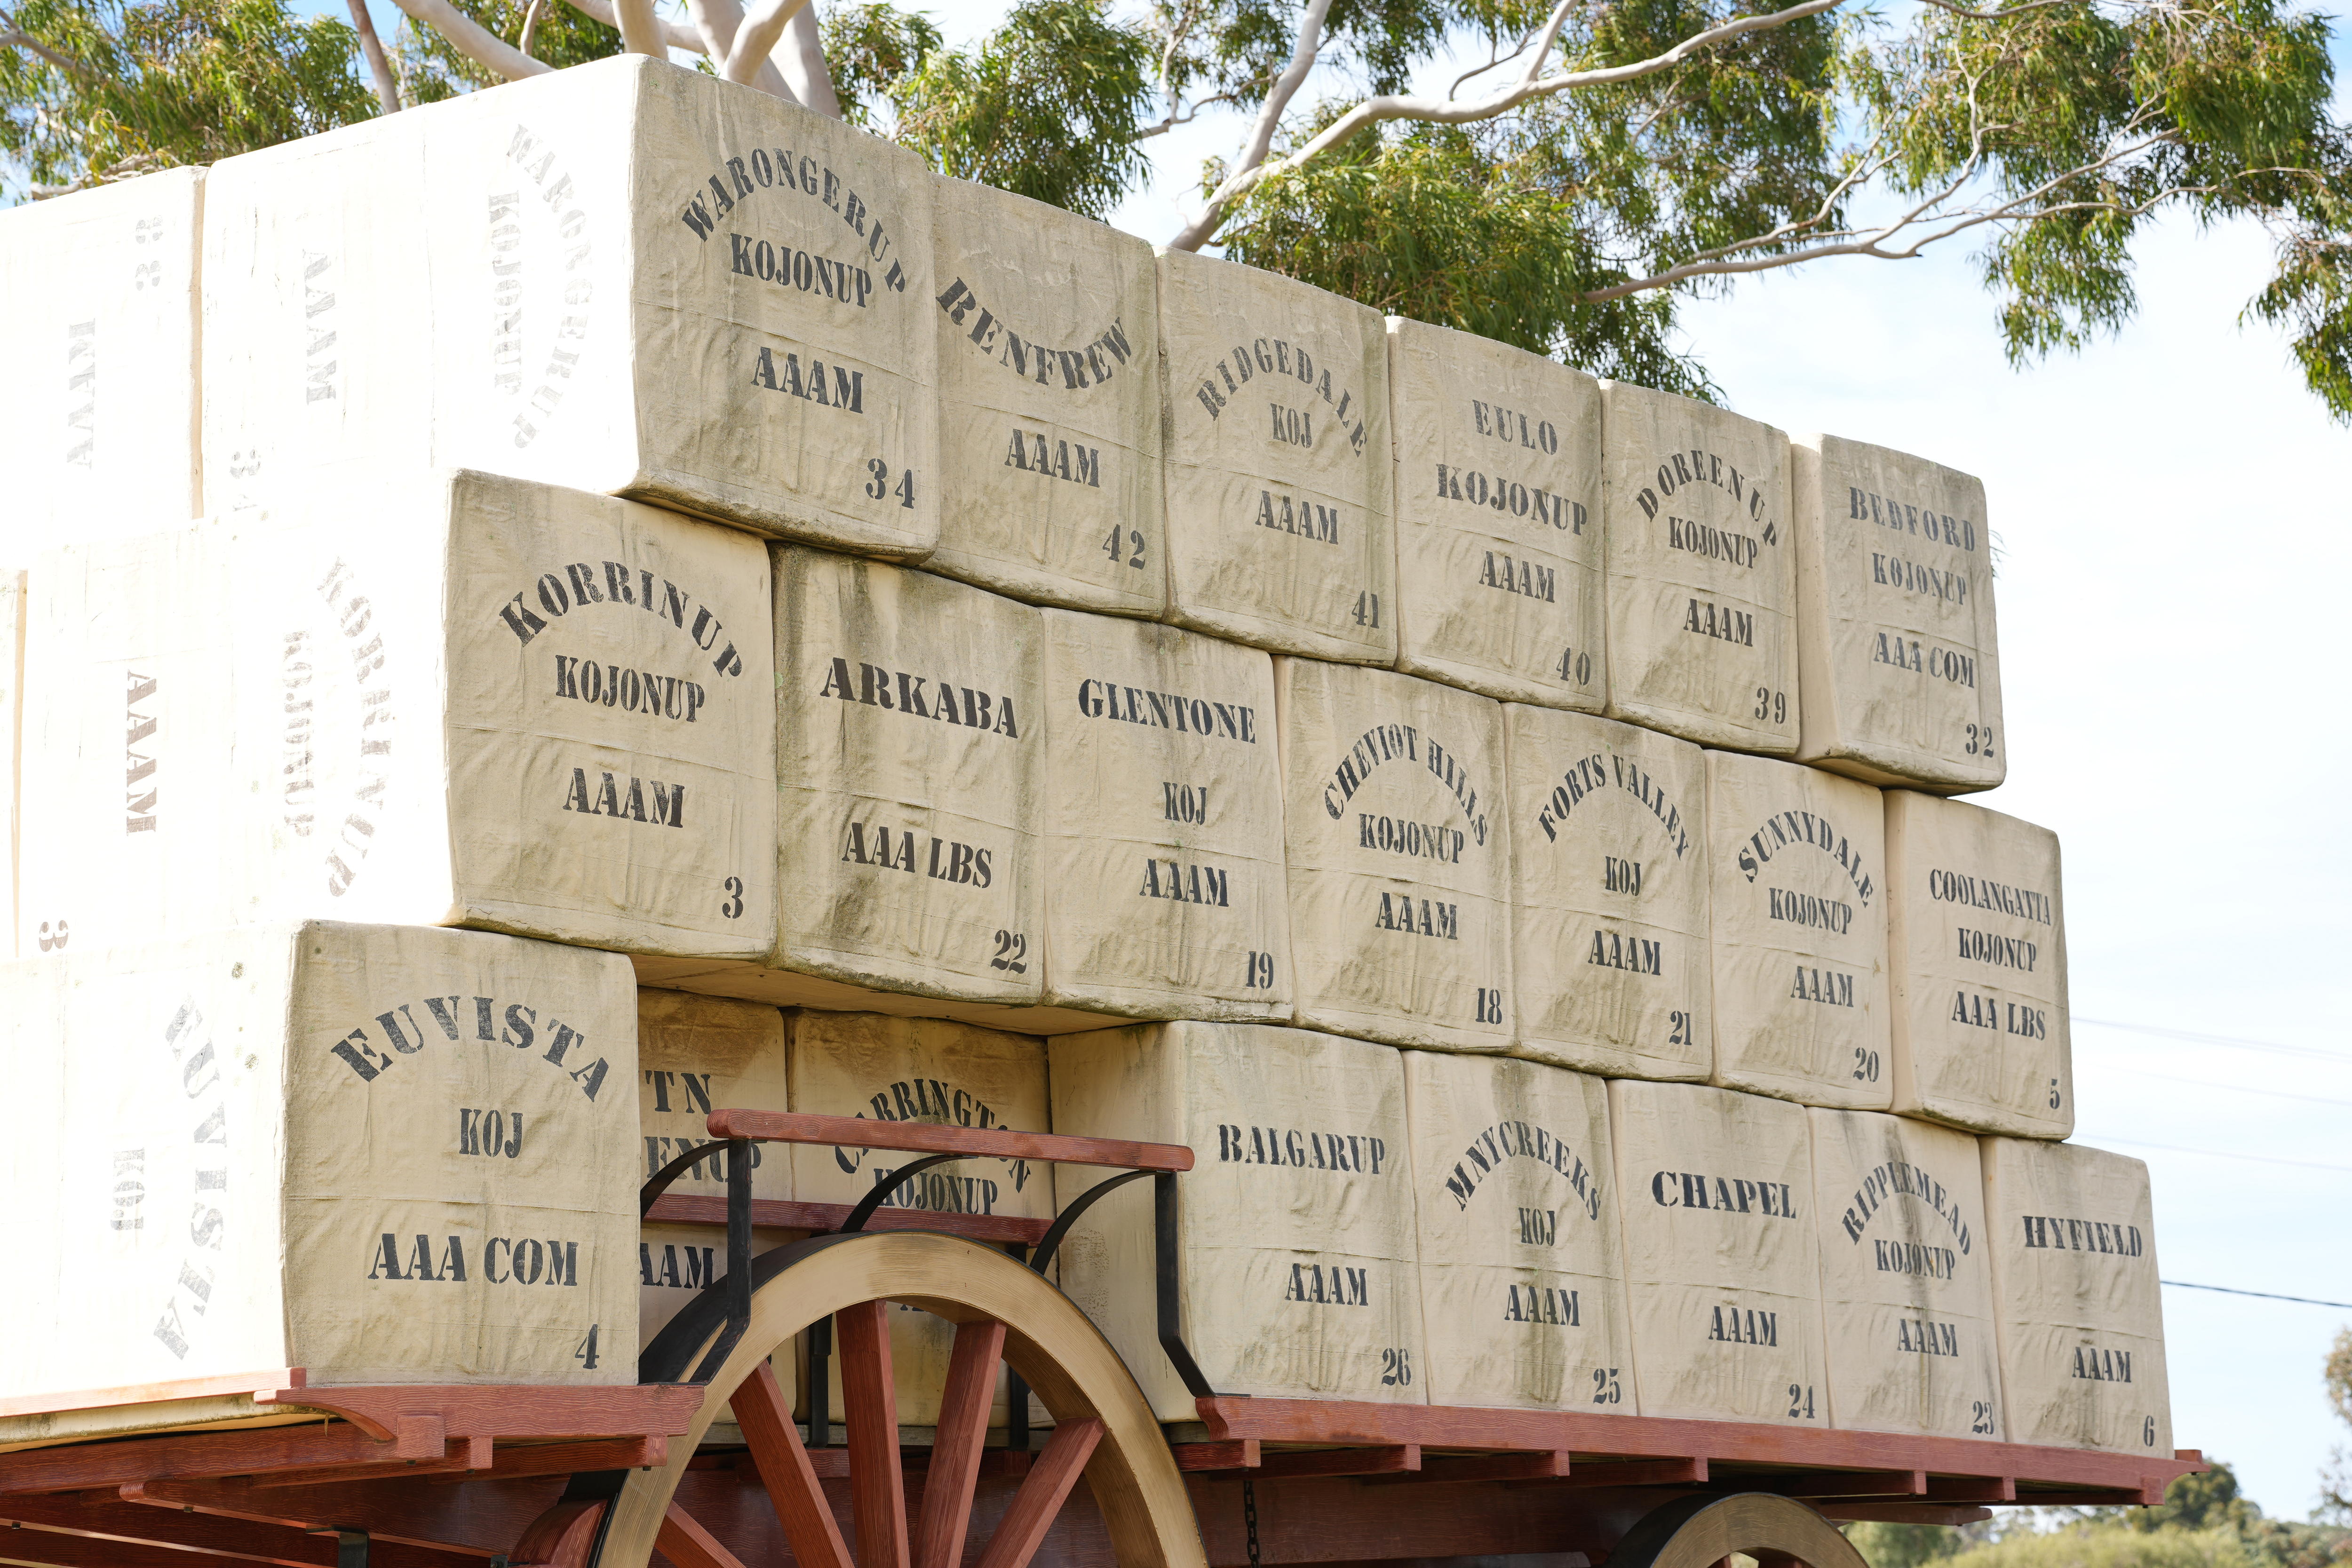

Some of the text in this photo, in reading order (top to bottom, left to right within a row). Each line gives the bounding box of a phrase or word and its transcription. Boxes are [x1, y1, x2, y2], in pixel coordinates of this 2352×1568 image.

[682, 148, 906, 293] WARONGERUP
[488, 190, 522, 395] KOJONUP
[731, 233, 872, 308] KOJONUP
[935, 277, 1132, 389] RENFREW
[751, 346, 864, 414] AAAM
[1196, 338, 1367, 458] RIDGEDALE
[1270, 403, 1312, 449] KOJ
[1472, 399, 1557, 455] EULO
[866, 458, 915, 509] 34
[1004, 429, 1100, 487] AAAM
[1255, 490, 1338, 545] AAAM
[1436, 463, 1587, 536] KOJONUP
[1637, 450, 1777, 547] DOREENUP
[1850, 486, 1975, 552] BEDFORD
[1102, 524, 1146, 570] 42
[1669, 516, 1757, 569] KOJONUP
[1479, 551, 1555, 604] AAAM
[1872, 553, 1967, 605] KOJONUP
[499, 561, 743, 678] KORRINUP
[1351, 590, 1380, 629] 41
[1683, 598, 1753, 647] AAAM
[1556, 647, 1590, 685] 40
[1874, 632, 1975, 689] AAA COM
[555, 654, 705, 723] KOJONUP
[820, 657, 1018, 739] ARKABA
[1078, 678, 1256, 744] GLENTONE
[1755, 687, 1786, 724] 39
[282, 627, 315, 837] KOJONUP
[316, 552, 392, 897] KORRINUP
[1965, 723, 1994, 758] 32
[126, 669, 158, 837] AAAM
[562, 767, 685, 828] AAAM
[1162, 781, 1207, 826] KOJ
[1324, 723, 1488, 847] CHEVIOT HILLS
[1539, 754, 1689, 861] FORTS VALLEY
[842, 822, 992, 889] AAA LBS
[1359, 813, 1464, 864] KOJONUP
[1738, 810, 1874, 909] SUNNYDALE
[722, 876, 744, 920] 3
[1139, 858, 1229, 907] AAAM
[1605, 855, 1641, 897] KOJ
[1930, 868, 2051, 926] COOLANGATTA
[38, 919, 69, 953] 3
[1375, 892, 1458, 940] AAAM
[1769, 887, 1852, 935] KOJONUP
[990, 929, 1027, 974] 22
[1245, 951, 1274, 989] 19
[1587, 930, 1661, 976] AAAM
[1957, 927, 2037, 972] KOJONUP
[1475, 988, 1503, 1025] 18
[1790, 966, 1854, 1008] AAAM
[1669, 1011, 1692, 1046] 21
[1951, 991, 2046, 1042] AAA LBS
[331, 995, 610, 1103] EUVISTA
[1852, 1047, 1879, 1083] 20
[2049, 1079, 2061, 1110] 5
[459, 1108, 523, 1159] KOJ
[834, 1078, 1031, 1194] CRRINGTN
[1217, 1124, 1385, 1175] BALGARUP
[110, 1146, 146, 1232] KOJ
[153, 991, 228, 1361] EUVISTA
[873, 1168, 998, 1215] KOJONUP
[1446, 1120, 1601, 1221] MNYCREEKS
[1652, 1171, 1796, 1219] CHAPEL
[1518, 1207, 1555, 1247] KOJ
[1842, 1162, 1971, 1256] RIPPLEMEAD
[367, 1233, 579, 1287] AAA COM
[1874, 1239, 1956, 1280] KOJONUP
[2022, 1216, 2143, 1258] HYFIELD
[1285, 1263, 1369, 1306] AAAM
[1504, 1285, 1581, 1327] AAAM
[574, 1324, 600, 1370] 4
[1708, 1305, 1778, 1347] AAAM
[1897, 1319, 1959, 1357] AAAM
[1381, 1348, 1411, 1386] 26
[1593, 1368, 1621, 1404] 25
[2072, 1346, 2132, 1383] AAAM
[1788, 1384, 1815, 1419] 24
[1971, 1401, 1994, 1435] 23
[2143, 1415, 2154, 1447] 6
